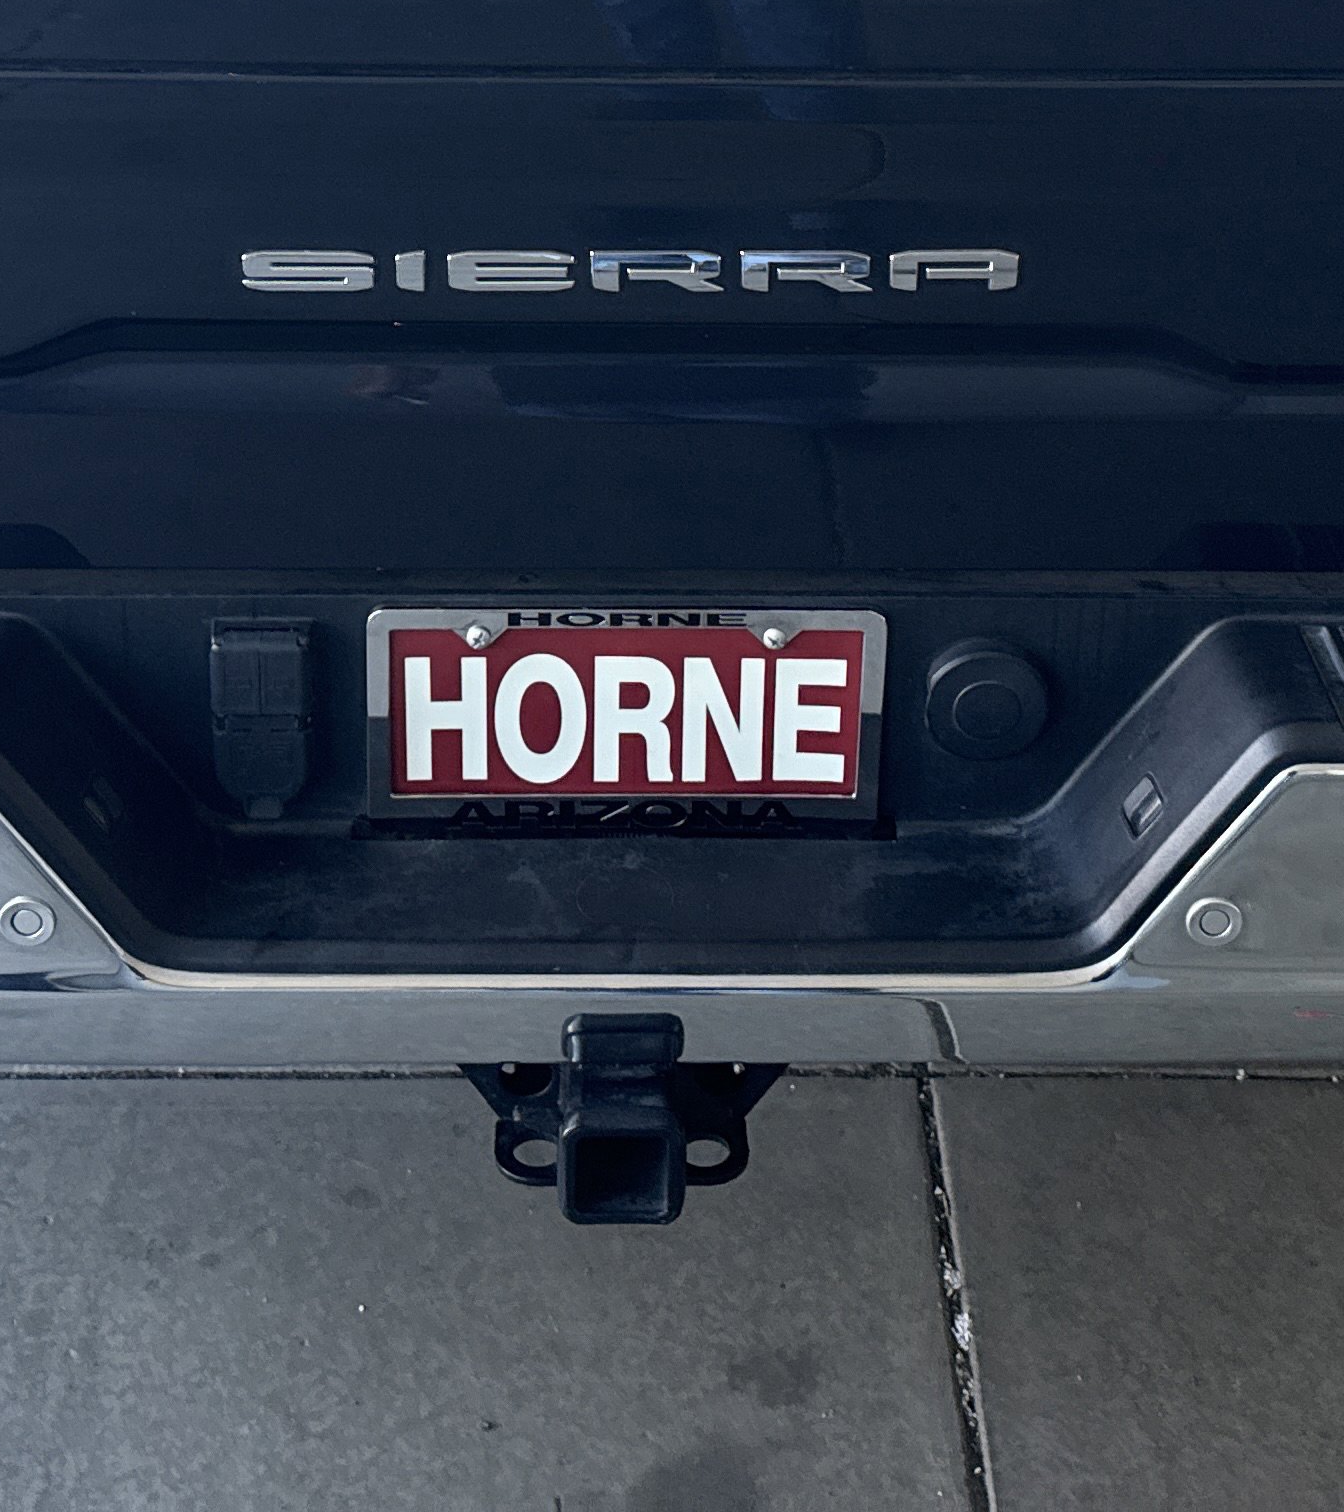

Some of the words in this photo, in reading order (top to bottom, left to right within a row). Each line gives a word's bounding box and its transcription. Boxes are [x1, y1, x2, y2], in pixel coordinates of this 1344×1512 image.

[241, 248, 1020, 292] SIERRA
[508, 612, 747, 627] HORNE
[404, 653, 848, 784] HORNE
[449, 799, 800, 828] ARIZONA
